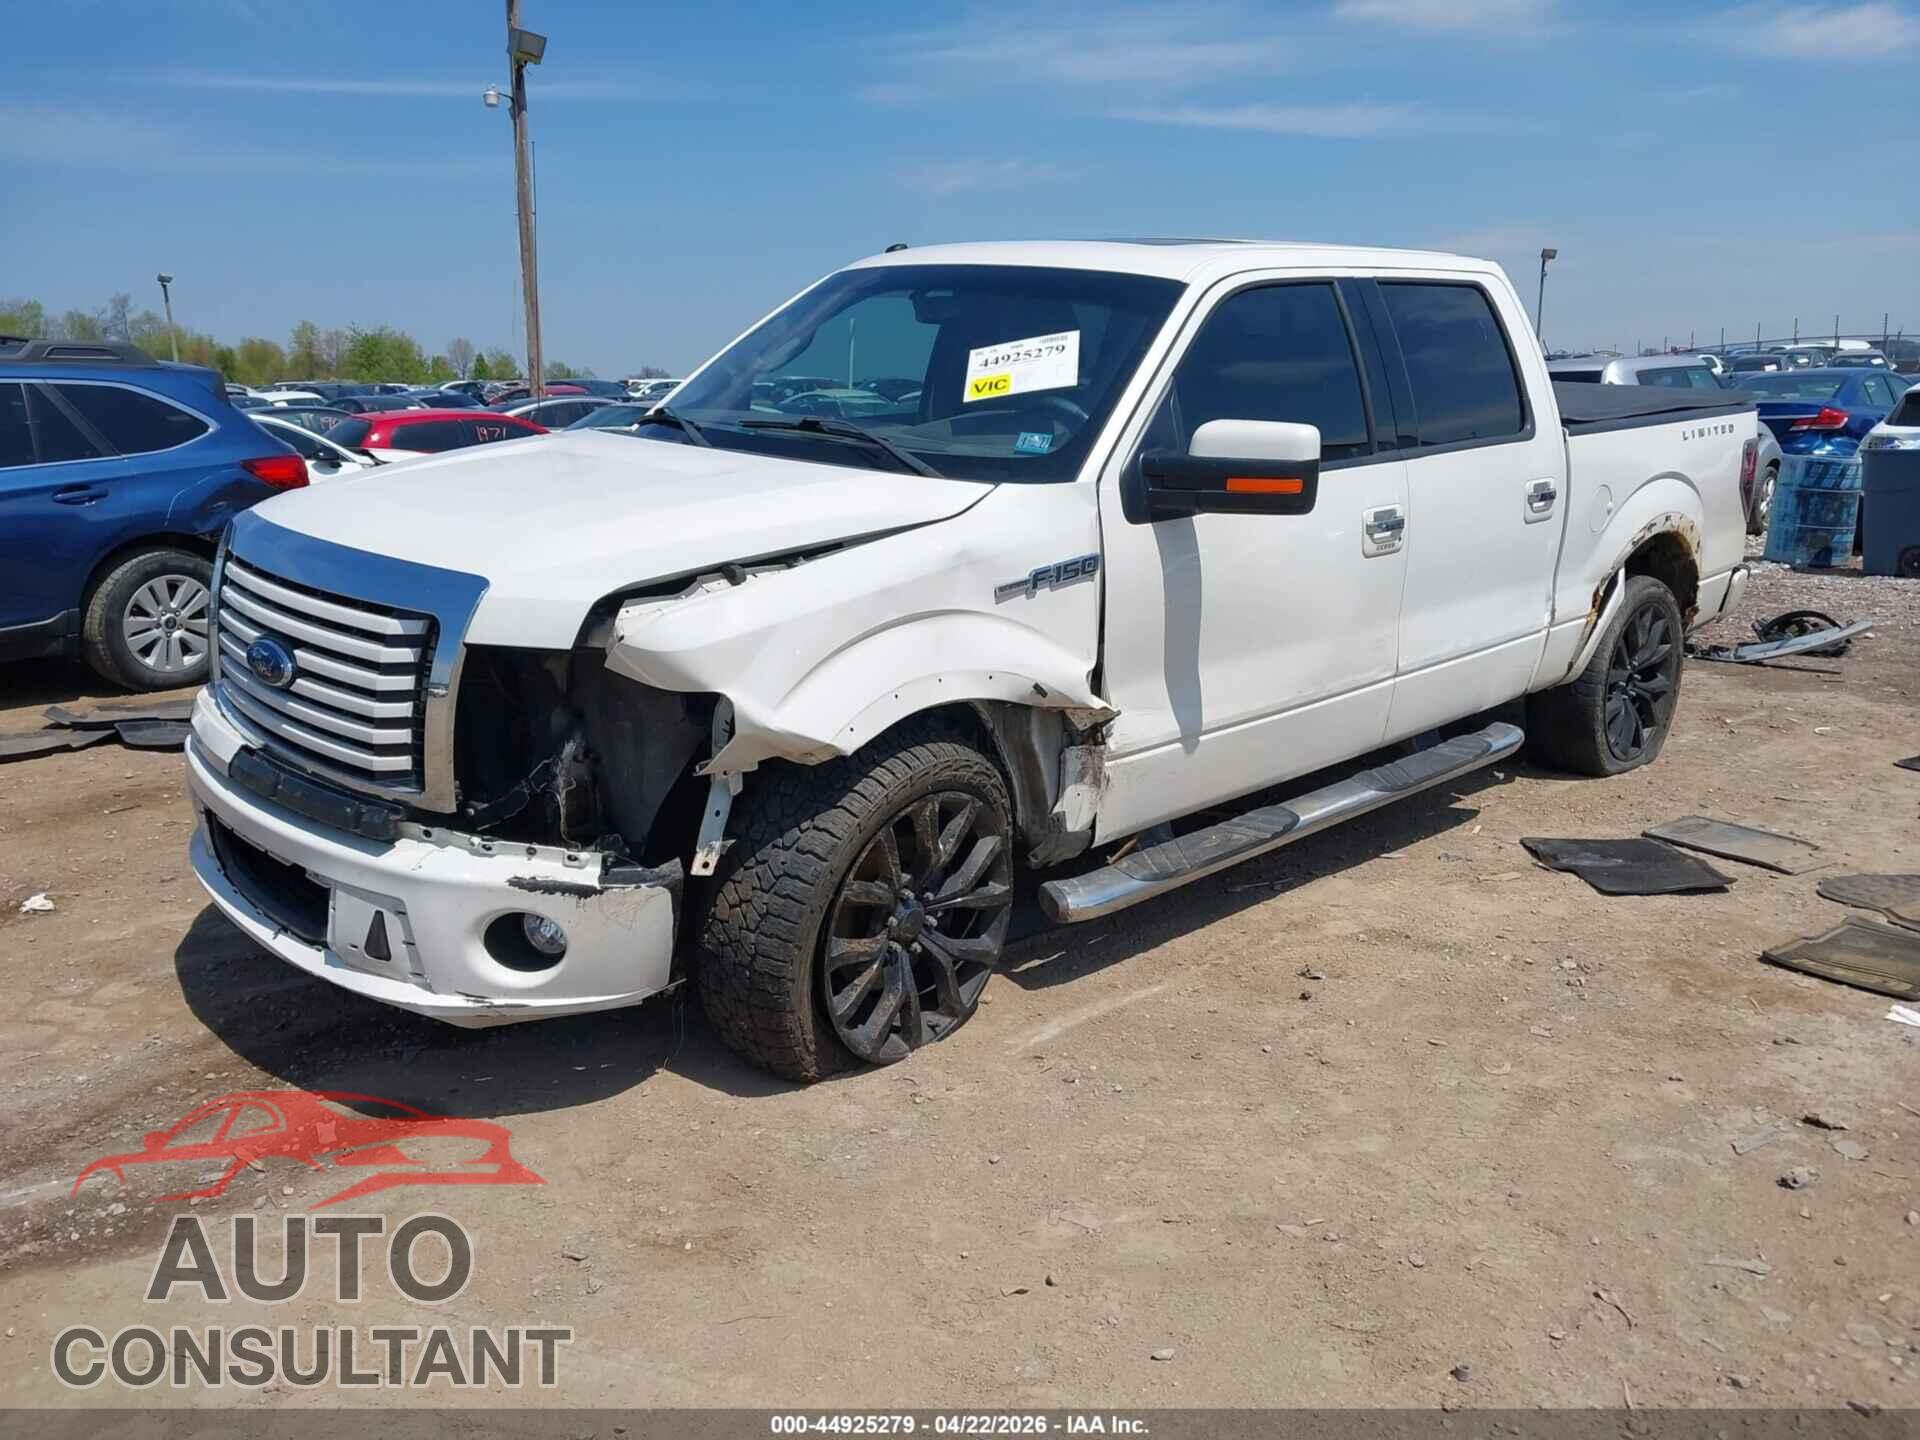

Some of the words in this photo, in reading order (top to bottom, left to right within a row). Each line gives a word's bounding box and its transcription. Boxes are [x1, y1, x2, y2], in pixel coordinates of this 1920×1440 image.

[979, 344, 1065, 367] 44925279
[974, 379, 1007, 393] VIC
[1682, 423, 1735, 440] LIMITED
